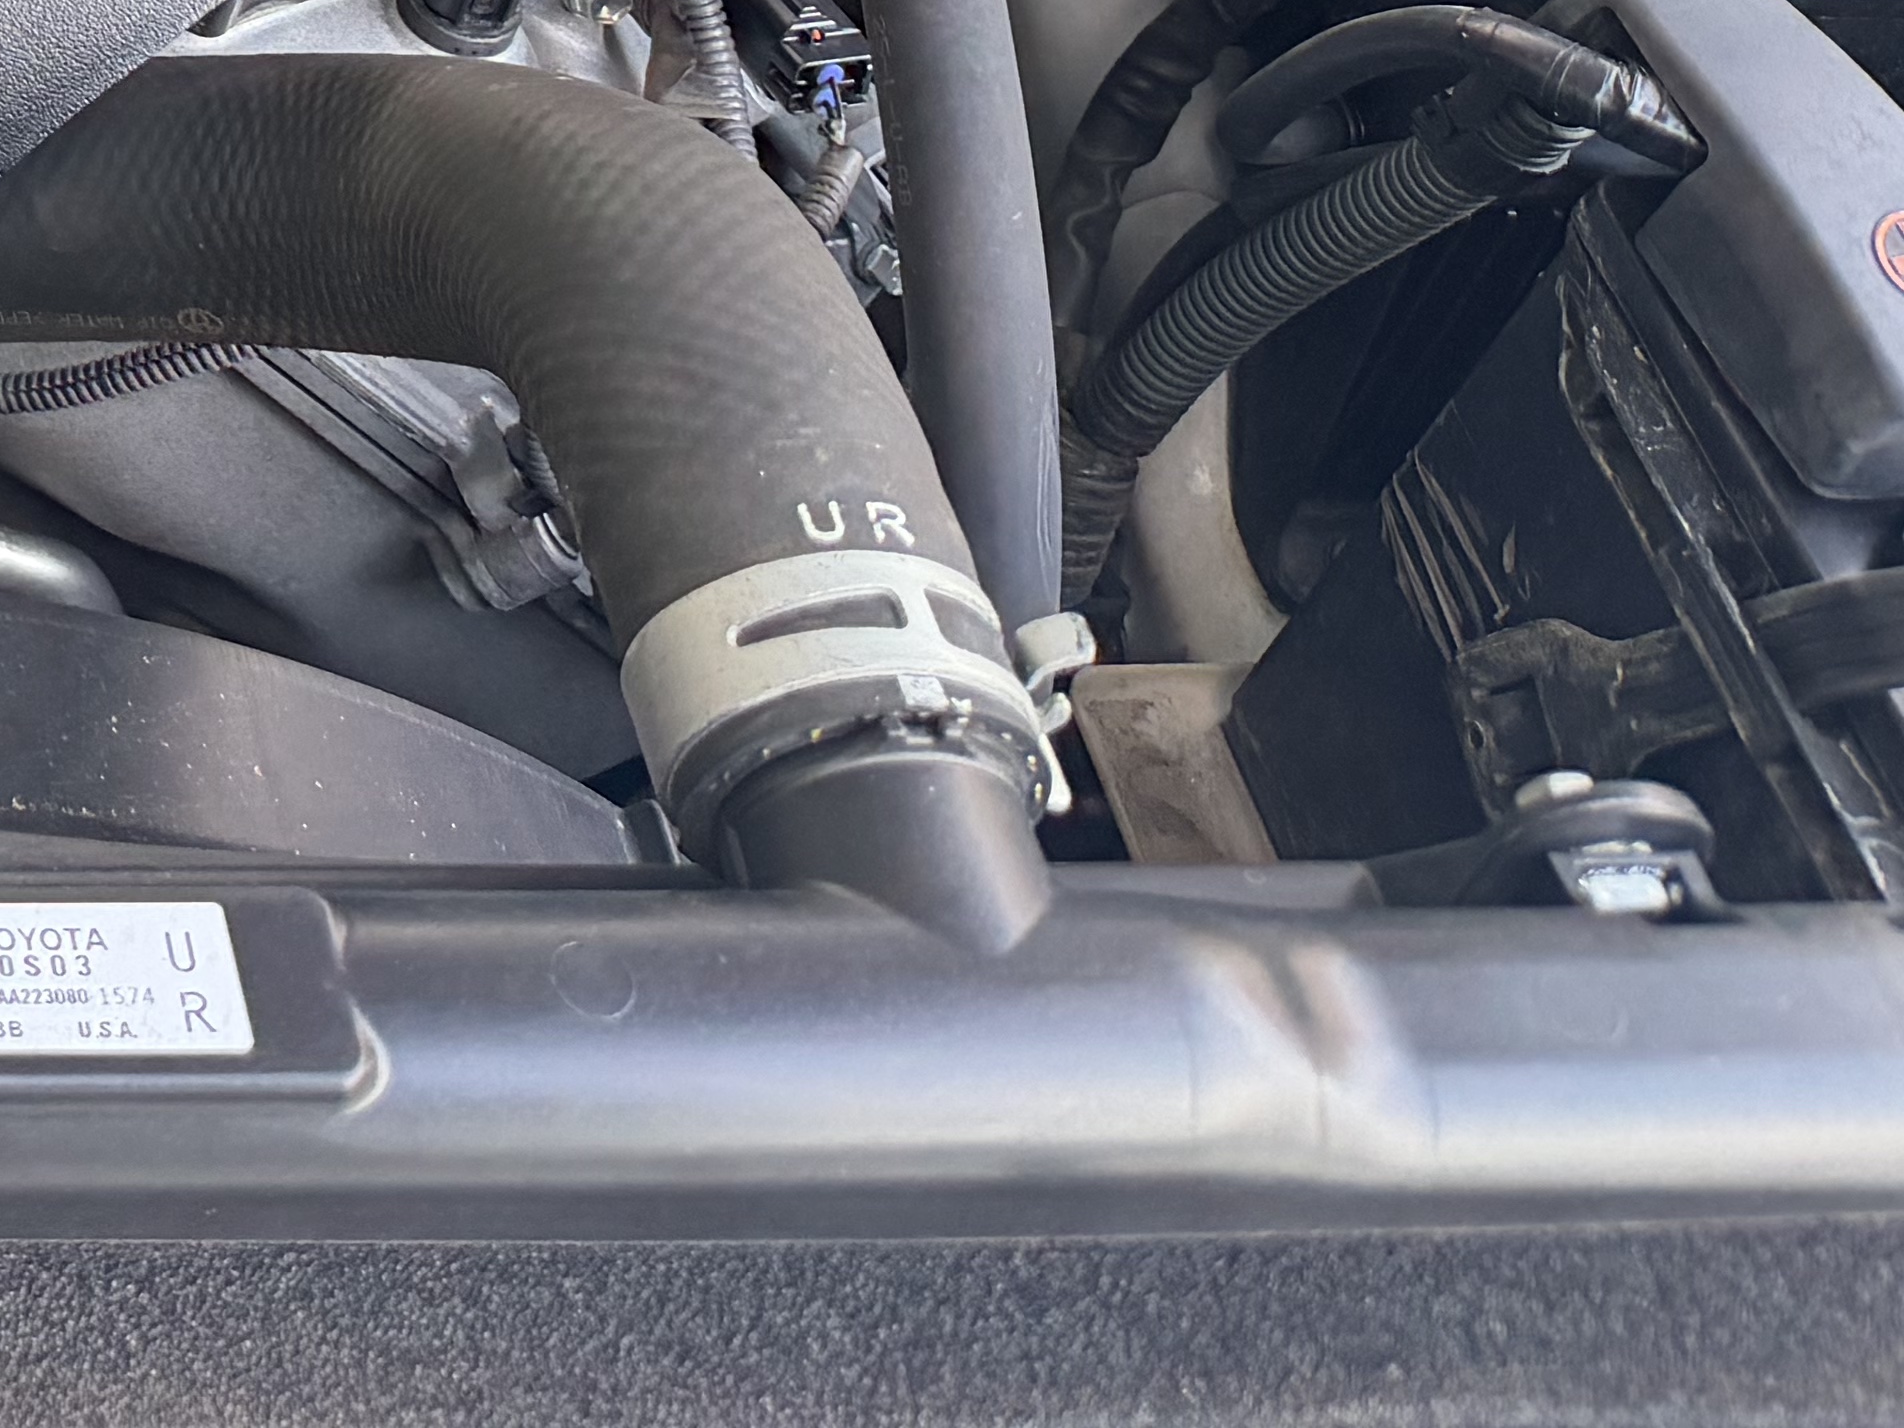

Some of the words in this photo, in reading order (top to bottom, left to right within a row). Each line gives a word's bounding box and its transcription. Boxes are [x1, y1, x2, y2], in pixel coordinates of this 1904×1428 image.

[164, 930, 197, 973] U
[77, 1020, 139, 1040] U.S.A.
[179, 991, 218, 1034] R
